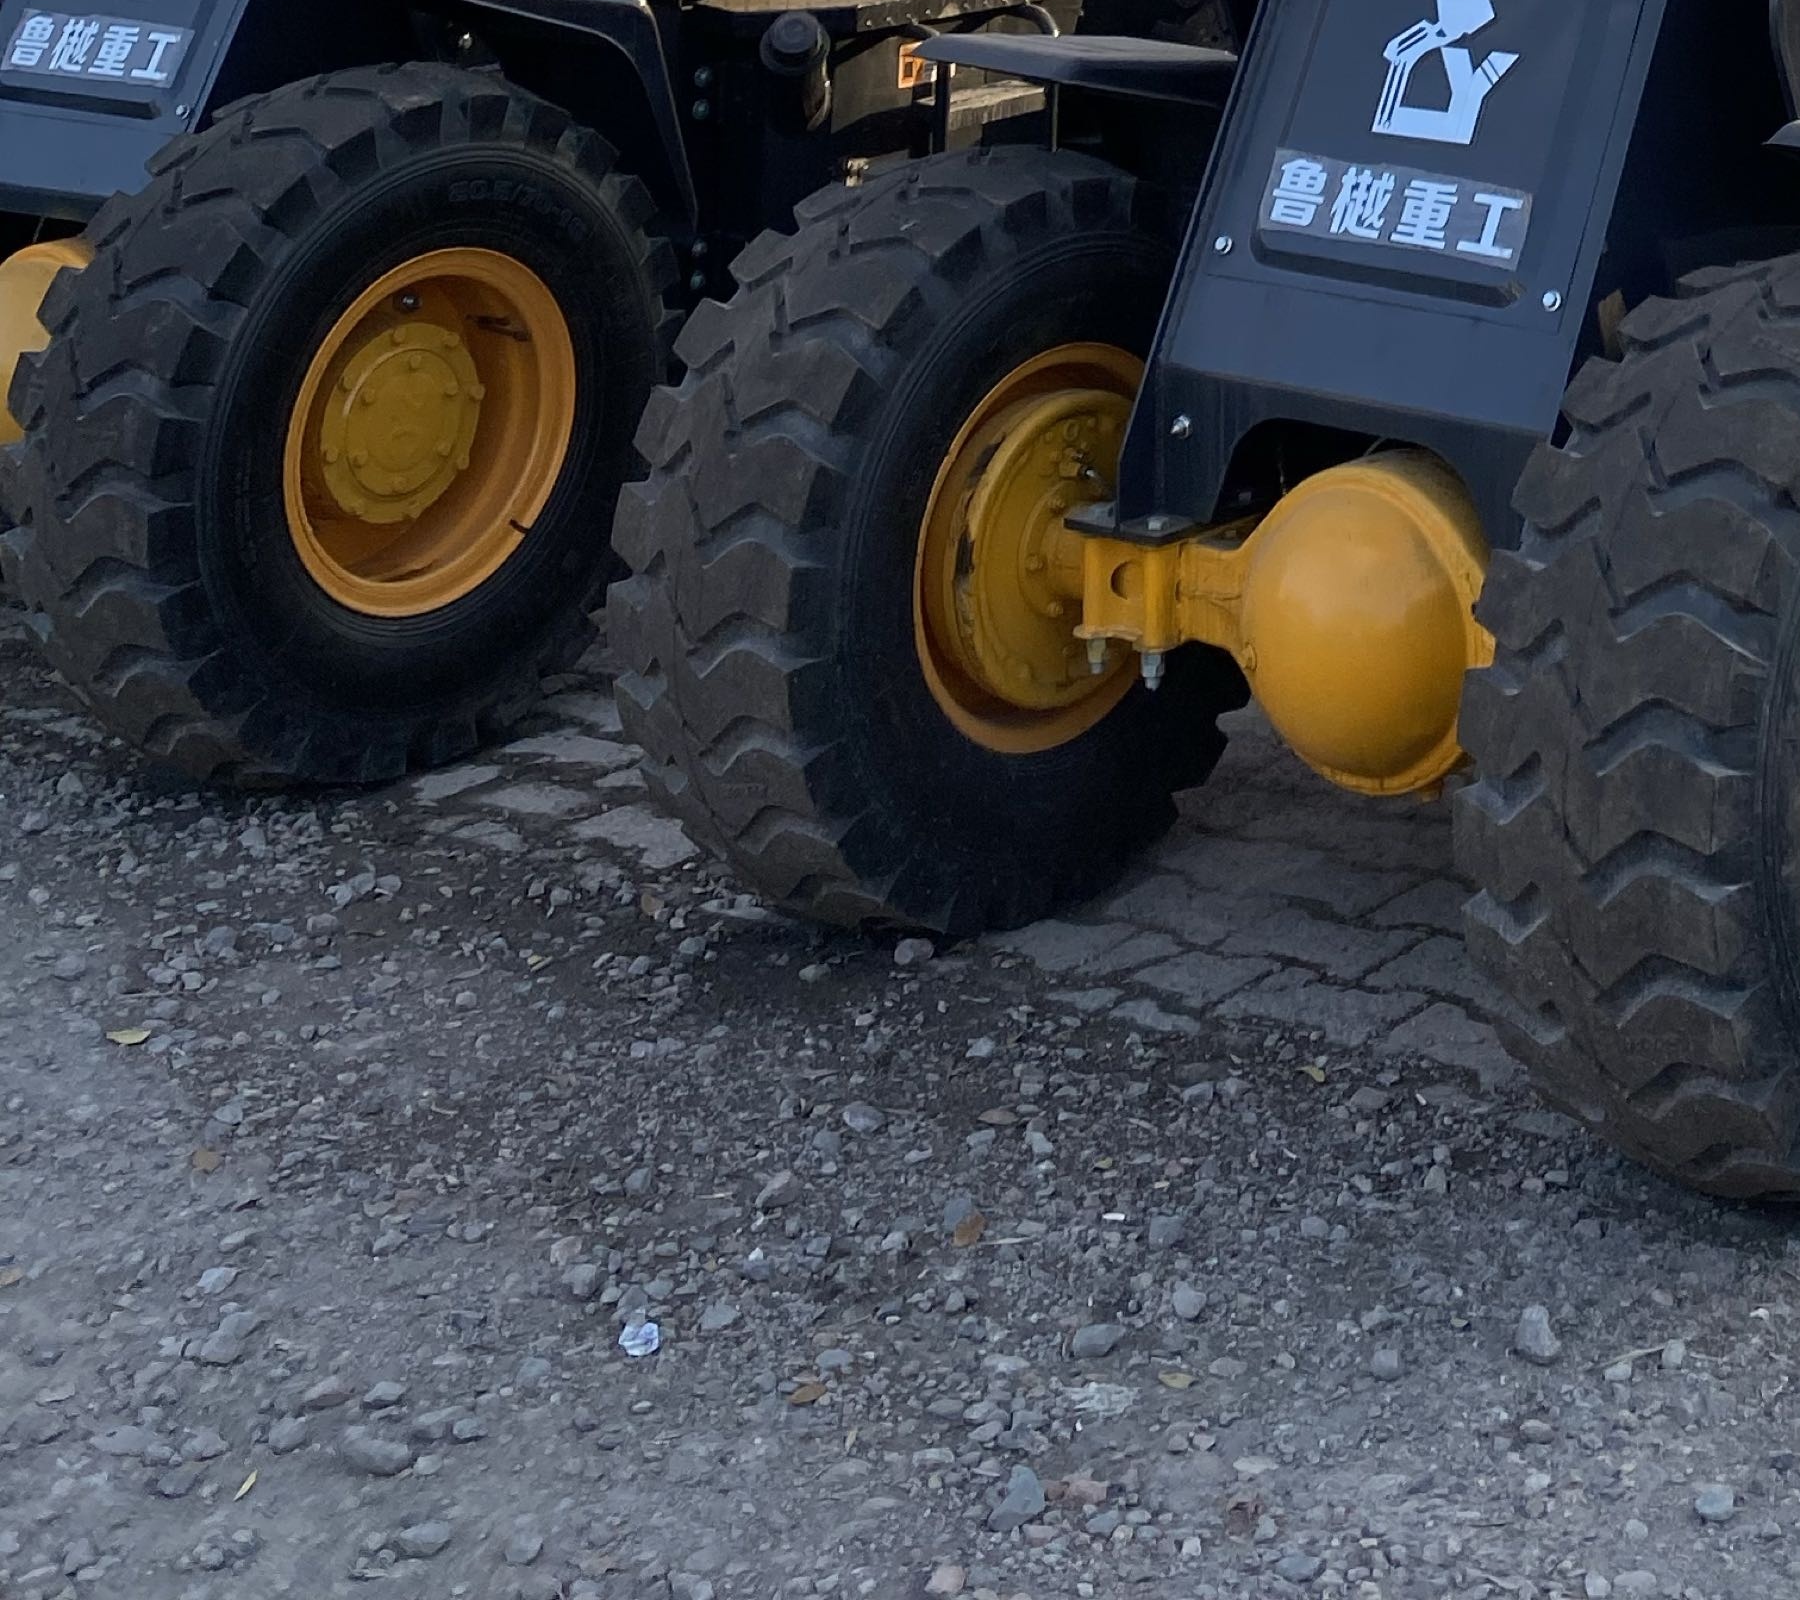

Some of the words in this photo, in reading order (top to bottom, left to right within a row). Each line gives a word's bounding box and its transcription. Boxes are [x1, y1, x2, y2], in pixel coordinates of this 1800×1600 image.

[10, 15, 182, 81] 鲁樾重工
[1268, 158, 1525, 260] 鲁樾重工
